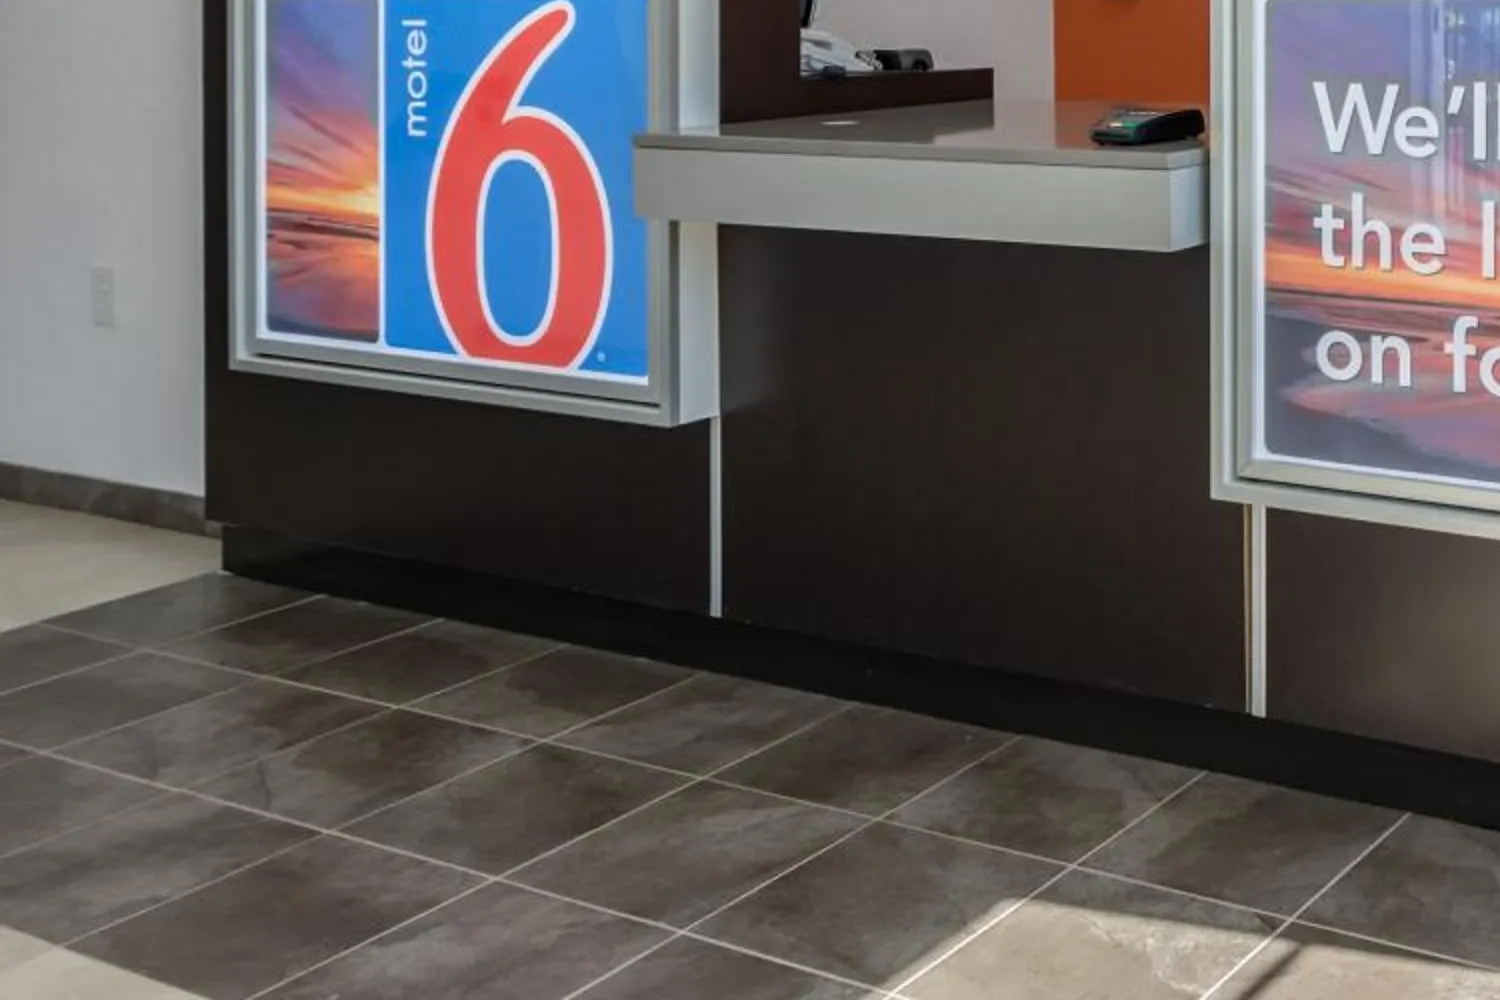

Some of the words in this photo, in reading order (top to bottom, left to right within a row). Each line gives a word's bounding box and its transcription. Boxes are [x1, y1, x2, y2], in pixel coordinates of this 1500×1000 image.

[402, 19, 428, 137] motel
[425, 0, 613, 372] 6
[1313, 191, 1447, 275] the
[1315, 329, 1413, 388] on
